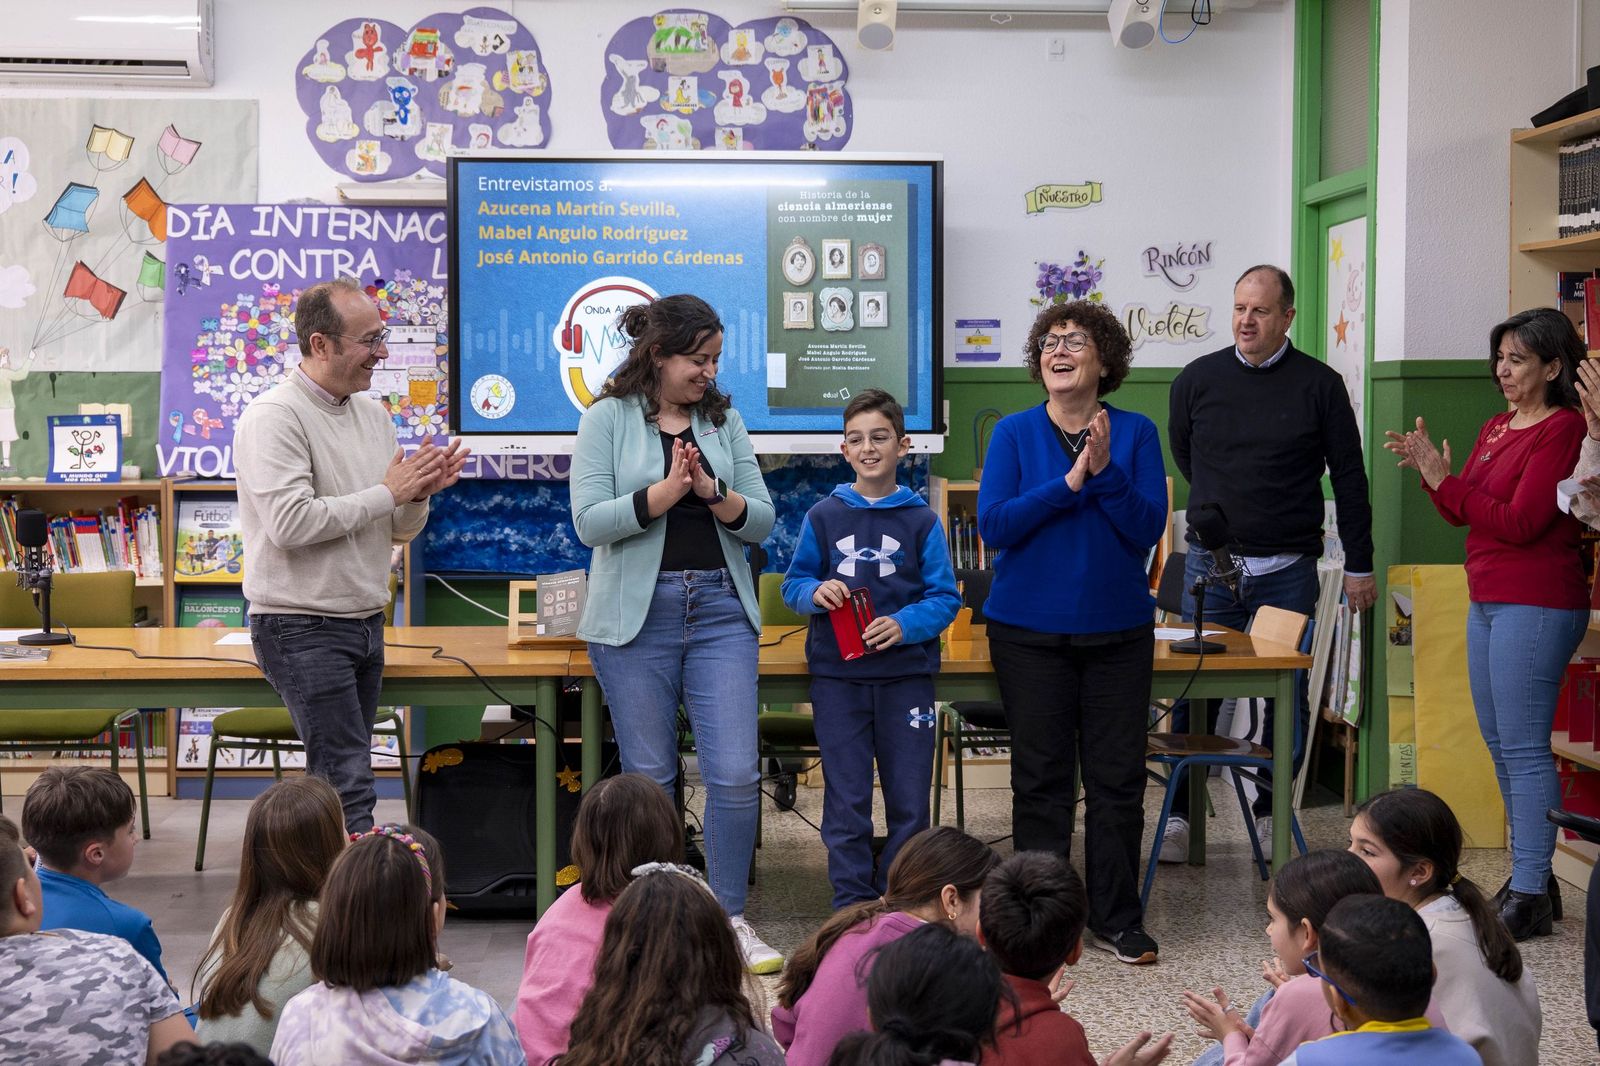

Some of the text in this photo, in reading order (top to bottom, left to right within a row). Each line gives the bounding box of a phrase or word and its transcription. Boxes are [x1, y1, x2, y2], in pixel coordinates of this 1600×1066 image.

[478, 176, 594, 192] Entrevistamos
[800, 190, 870, 200] Historia de la
[478, 200, 680, 219] Azucena Martín Sevilla,
[778, 201, 893, 211] ciencia almeriense
[166, 204, 236, 241] DÍA
[778, 213, 893, 223] con nombre de mujer
[479, 225, 688, 245] Mabel Angulo Rodríguez
[229, 247, 381, 280] CONTRA
[477, 249, 744, 268] José Antonio Garrido Cárdenas
[1143, 242, 1212, 287] RINCÓN
[1128, 304, 1208, 341] Violeta
[193, 509, 233, 522] Fútbol
[184, 605, 241, 614] BALONCESTO
